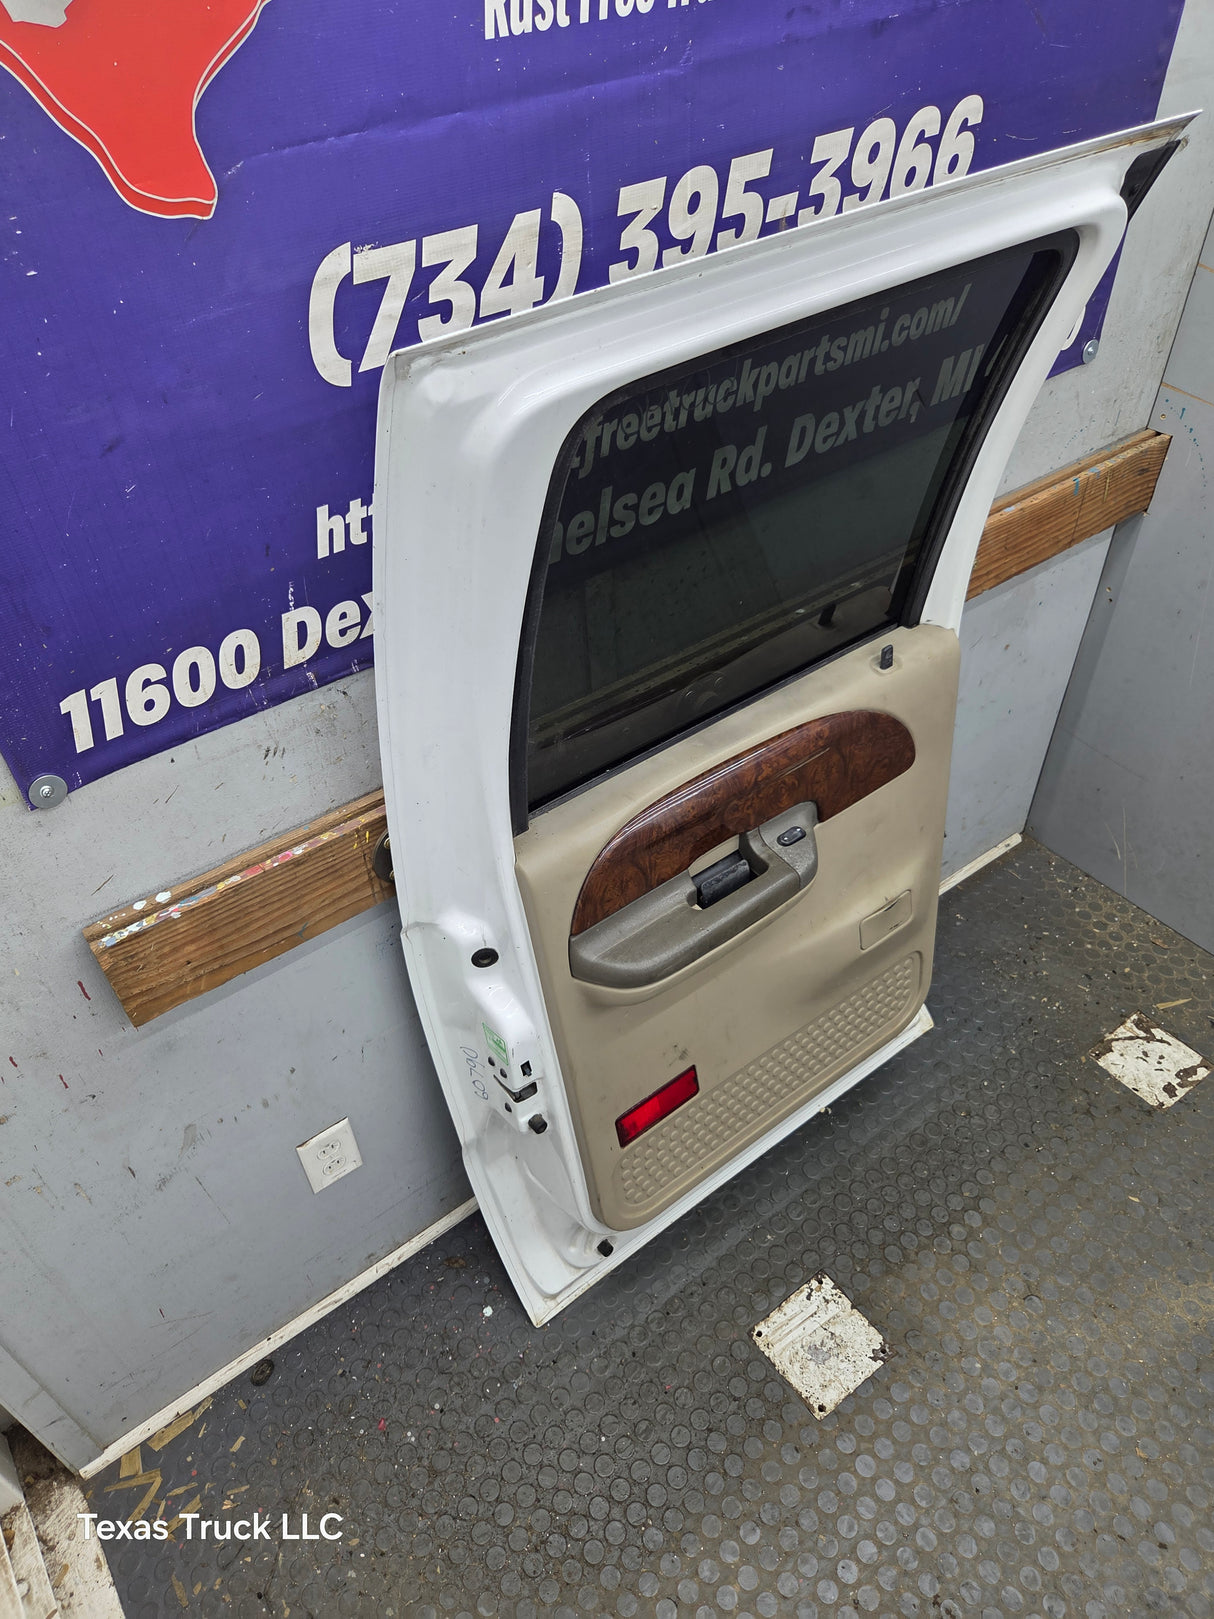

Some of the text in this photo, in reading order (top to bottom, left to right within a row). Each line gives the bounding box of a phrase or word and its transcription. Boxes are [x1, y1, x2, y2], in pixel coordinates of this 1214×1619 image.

[309, 94, 984, 386] (734) 395-3966
[59, 629, 261, 754] 11600
[706, 426, 774, 500] Rd.
[784, 376, 921, 469] Dexter,
[316, 283, 973, 560] ht freetruckpartsmi.com/
